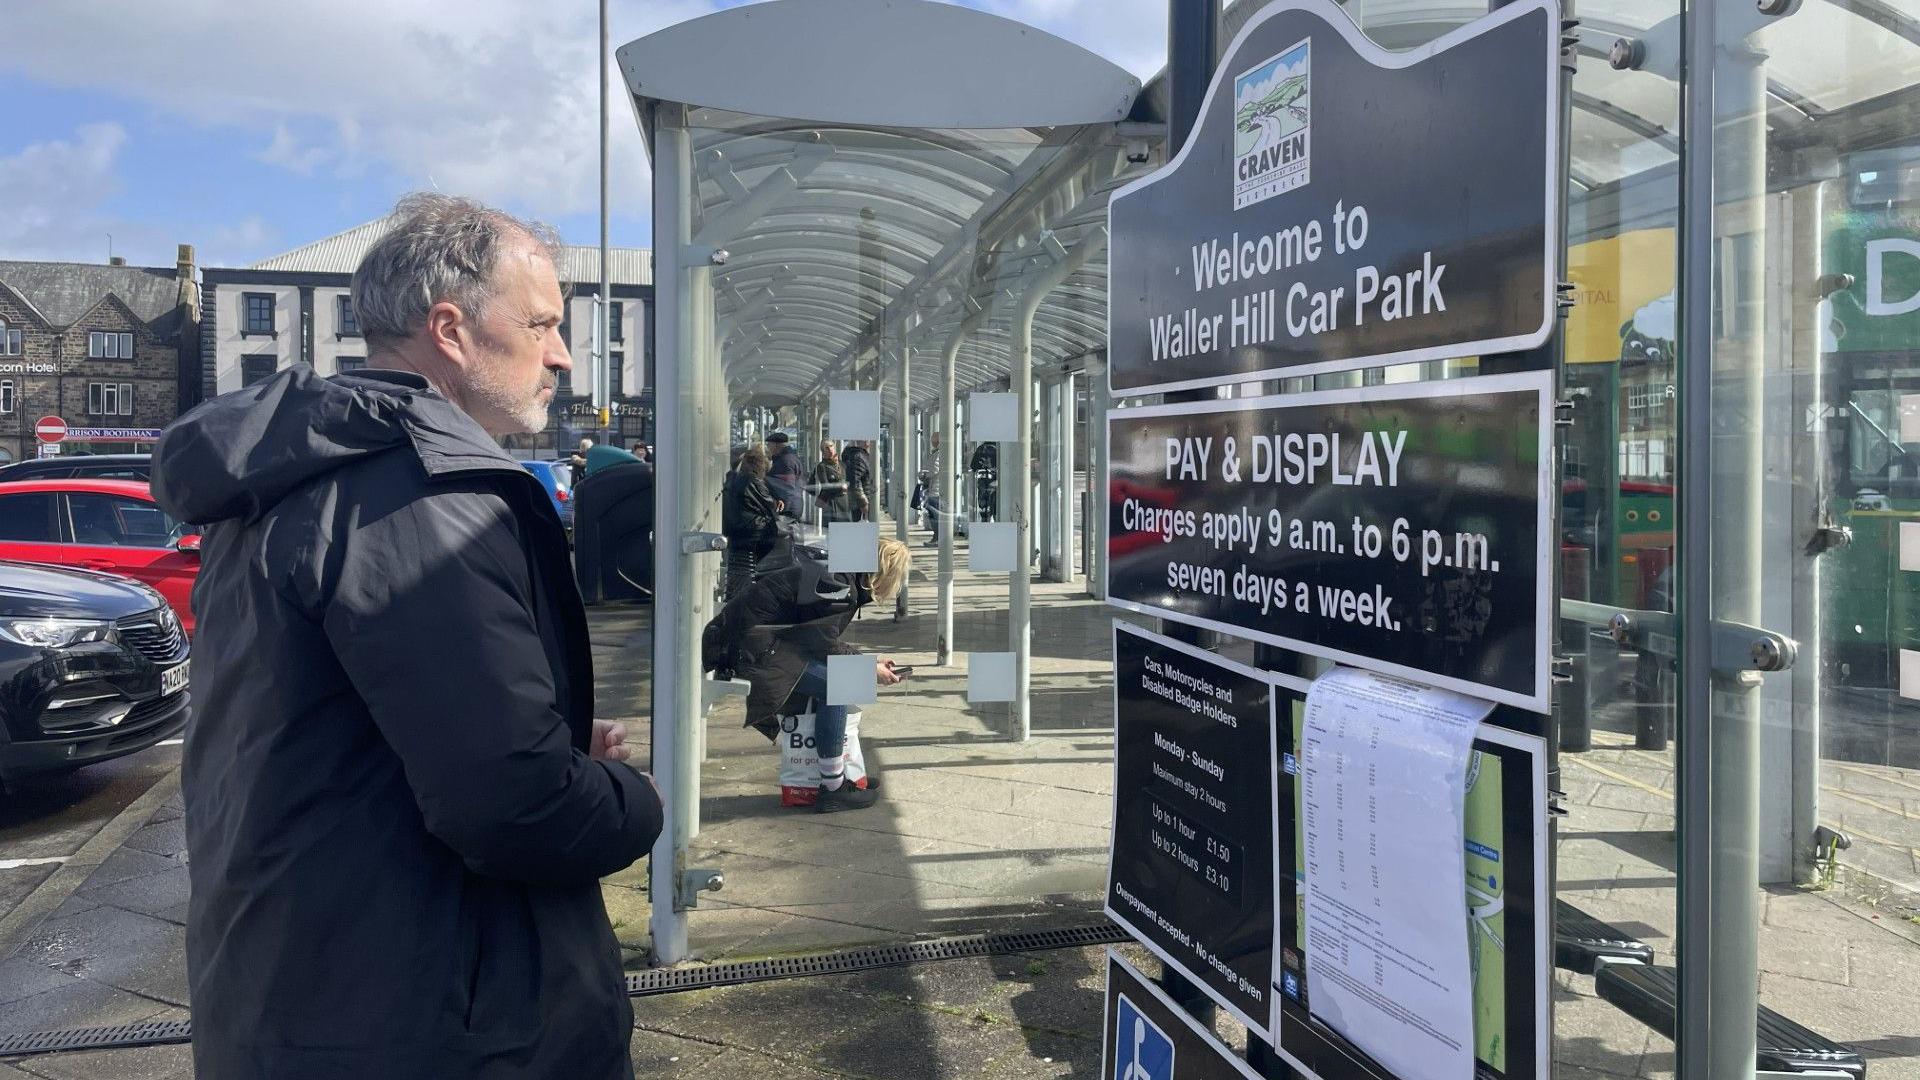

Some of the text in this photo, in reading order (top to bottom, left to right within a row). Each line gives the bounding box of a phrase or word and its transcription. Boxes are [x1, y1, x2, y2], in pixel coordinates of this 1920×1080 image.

[1239, 133, 1305, 181] CRAVEN
[1238, 173, 1305, 206] DISTRICT
[1192, 198, 1368, 292] Welcome to
[1149, 252, 1447, 361] Waller Hill Car Park
[26, 362, 57, 373] Hotel
[65, 428, 152, 438] ARRISON BOOTHMAN
[1166, 430, 1408, 487] PAY & DISPLAY
[1123, 498, 1500, 576] Charges apply 9 a.m. to 6 p.m.
[1167, 560, 1401, 632] seven days a week.
[1142, 675, 1237, 729] Disabled Badge Holders
[1144, 655, 1233, 704] Cars, Motorcycles and
[1154, 731, 1186, 762] Monday
[1192, 751, 1225, 782] Sunday
[1153, 761, 1227, 813] Maximum stay 2 hours
[1152, 802, 1230, 863] Up to 1 hour £1.50
[1152, 828, 1229, 892] Up to 2 hours £3.10
[1115, 881, 1158, 924] Overpayment
[1158, 914, 1190, 947] accepted
[1196, 941, 1207, 961] No
[1208, 951, 1237, 985] change
[1239, 976, 1262, 1002] given
